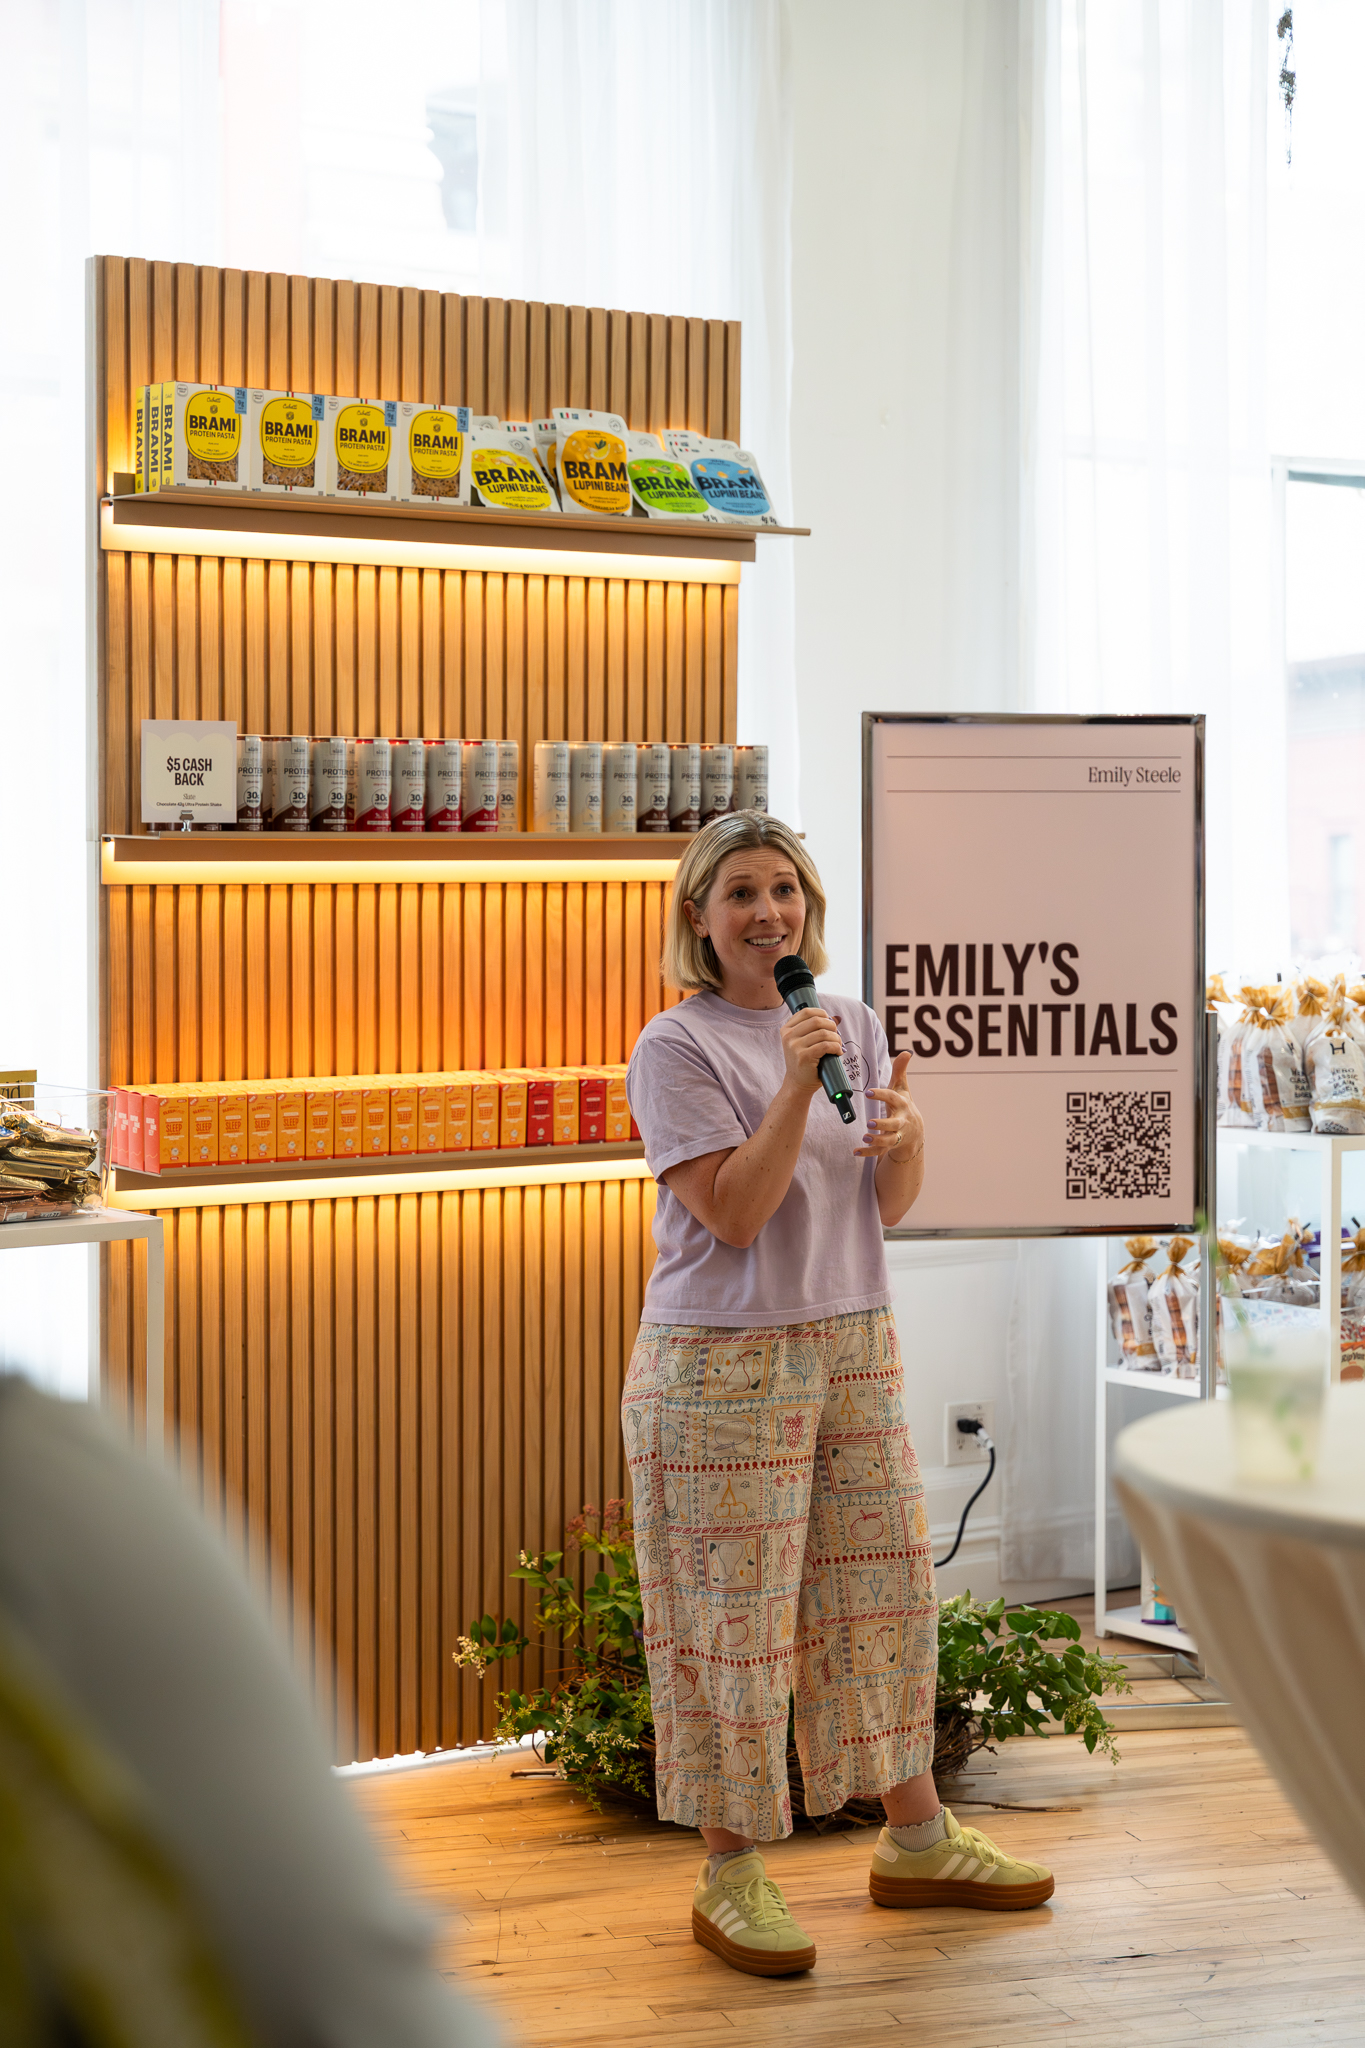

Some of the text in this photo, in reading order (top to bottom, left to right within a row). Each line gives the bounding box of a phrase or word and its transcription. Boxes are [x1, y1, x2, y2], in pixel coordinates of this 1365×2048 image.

[189, 415, 236, 432] BRAMI
[190, 430, 235, 440] PROTEIN PASTA
[265, 421, 313, 438] BRAMI
[151, 406, 159, 473] BRAMI
[163, 404, 173, 471] BRAMI
[265, 436, 312, 446] PROTEIN PASTA
[339, 428, 385, 444] BRAMI
[413, 433, 458, 450] BRAMI
[340, 442, 385, 452] PROTEIN PASTA
[414, 448, 457, 457] PROTEIN PASTA
[487, 483, 549, 494] LUPINI BEANS
[573, 480, 604, 491] LUPINI
[646, 490, 678, 499] LUPINI
[708, 490, 739, 499] LUPINI
[166, 756, 213, 773] $5 CASH
[174, 772, 205, 786] BACK
[1088, 766, 1181, 787] Emily Steele
[885, 940, 1080, 997] EMILY'S
[885, 1002, 1178, 1058] ESSENTIALS
[166, 1123, 182, 1133] SLEEP
[196, 1122, 212, 1132] SLEEP
[225, 1121, 242, 1130] SLEEP
[254, 1120, 271, 1129] SLEEP
